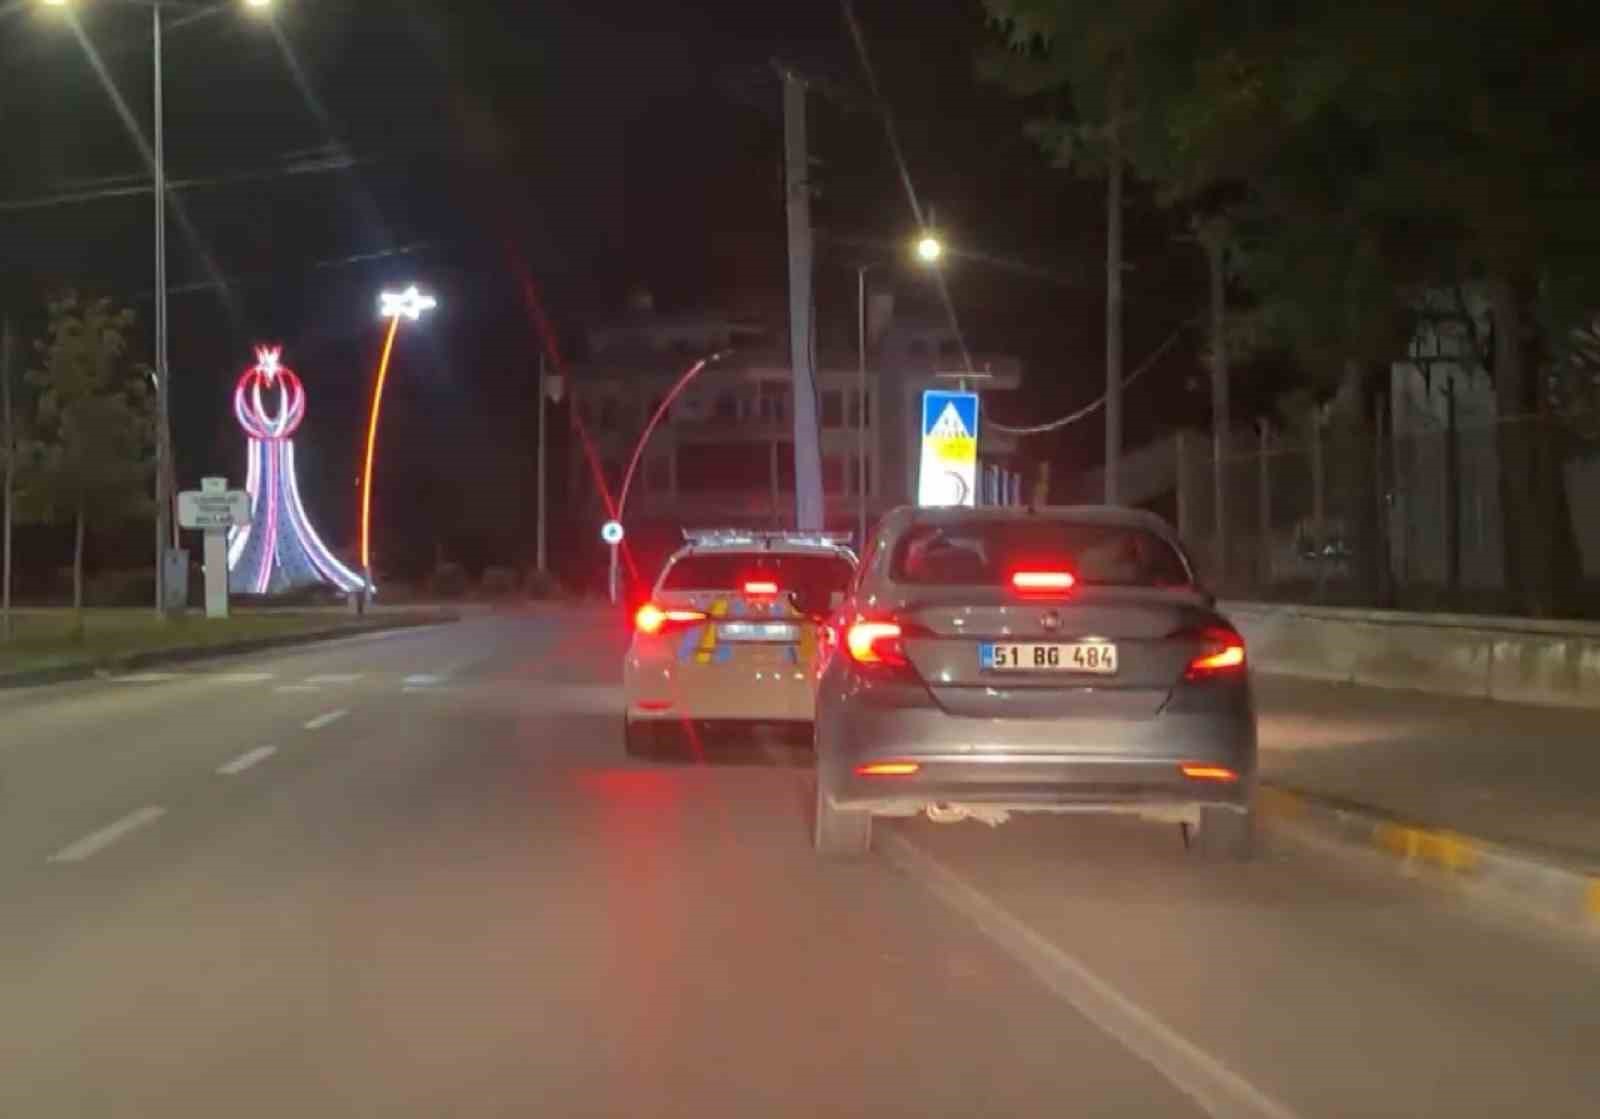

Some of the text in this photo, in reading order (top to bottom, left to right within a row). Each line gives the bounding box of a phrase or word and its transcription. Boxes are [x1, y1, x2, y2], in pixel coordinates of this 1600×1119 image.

[995, 646, 1112, 667] 51 BG 484
